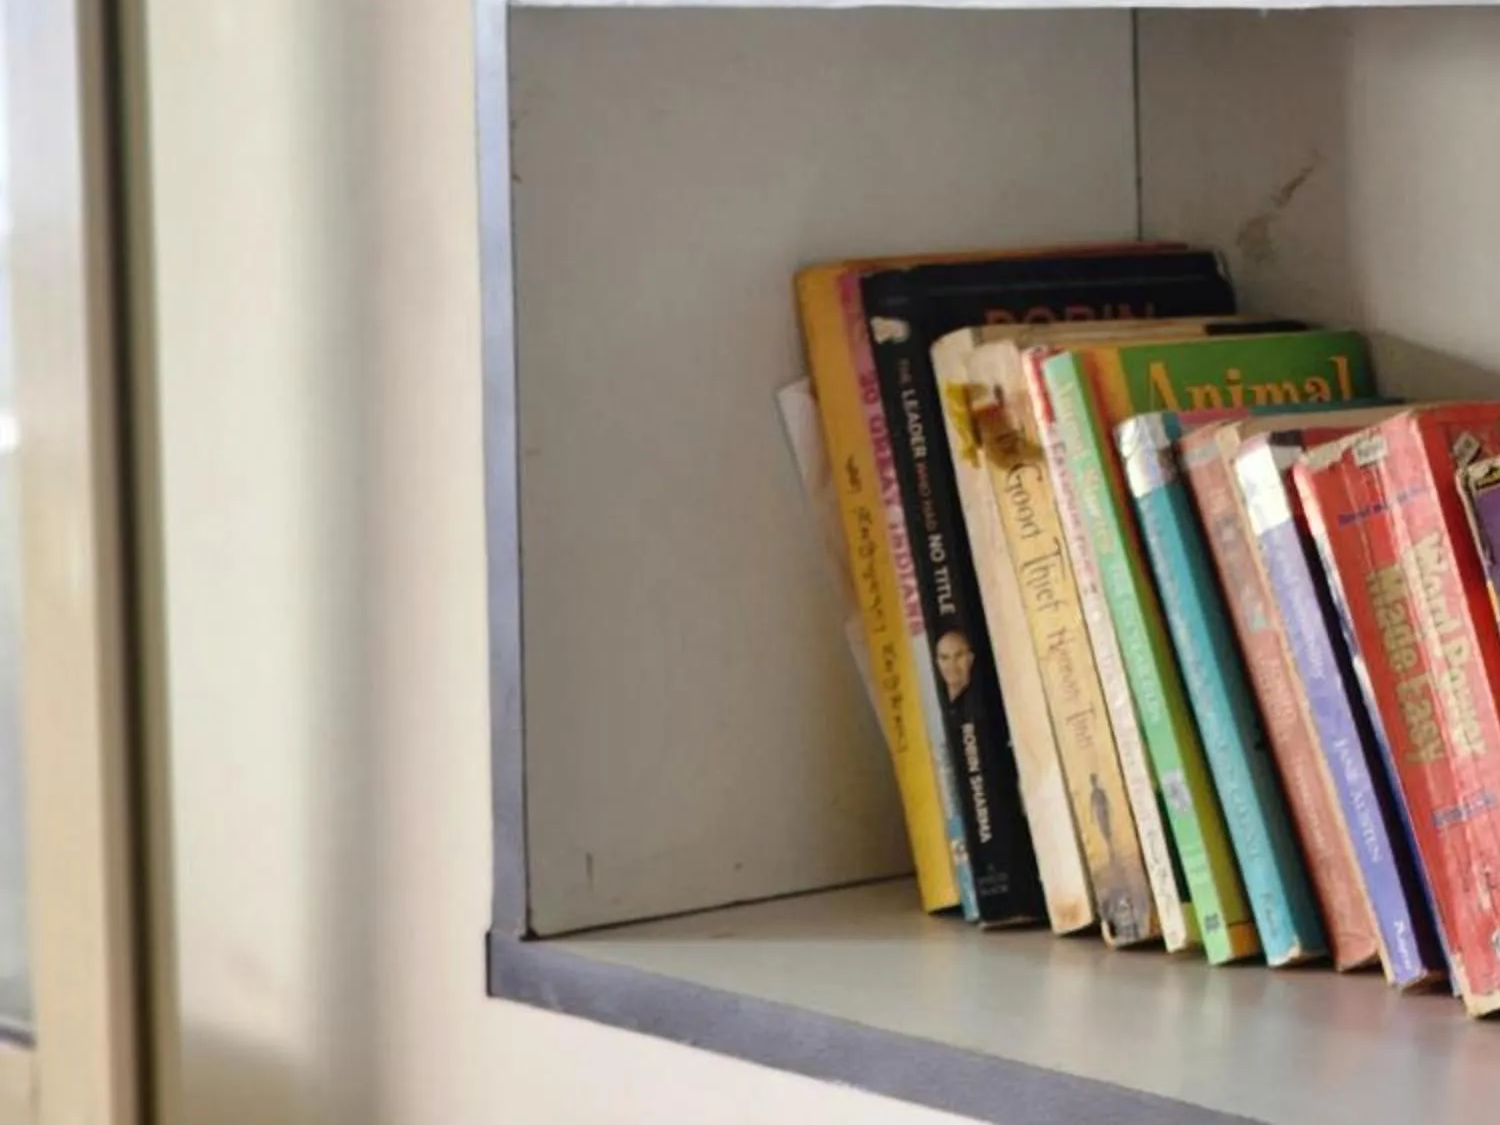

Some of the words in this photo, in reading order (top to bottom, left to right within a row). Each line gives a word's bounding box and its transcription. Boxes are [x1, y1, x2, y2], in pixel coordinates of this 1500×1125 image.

[1148, 355, 1354, 412] Animal
[902, 388, 927, 459] LEADER
[927, 533, 946, 563] NO
[932, 565, 956, 615] TITLE
[1366, 563, 1418, 673] Made
[1397, 672, 1447, 765] Easy
[1402, 531, 1463, 635] Word
[1441, 636, 1489, 758] Power
[969, 775, 993, 843] SHARMA
[1354, 791, 1383, 863] AUSTEN
